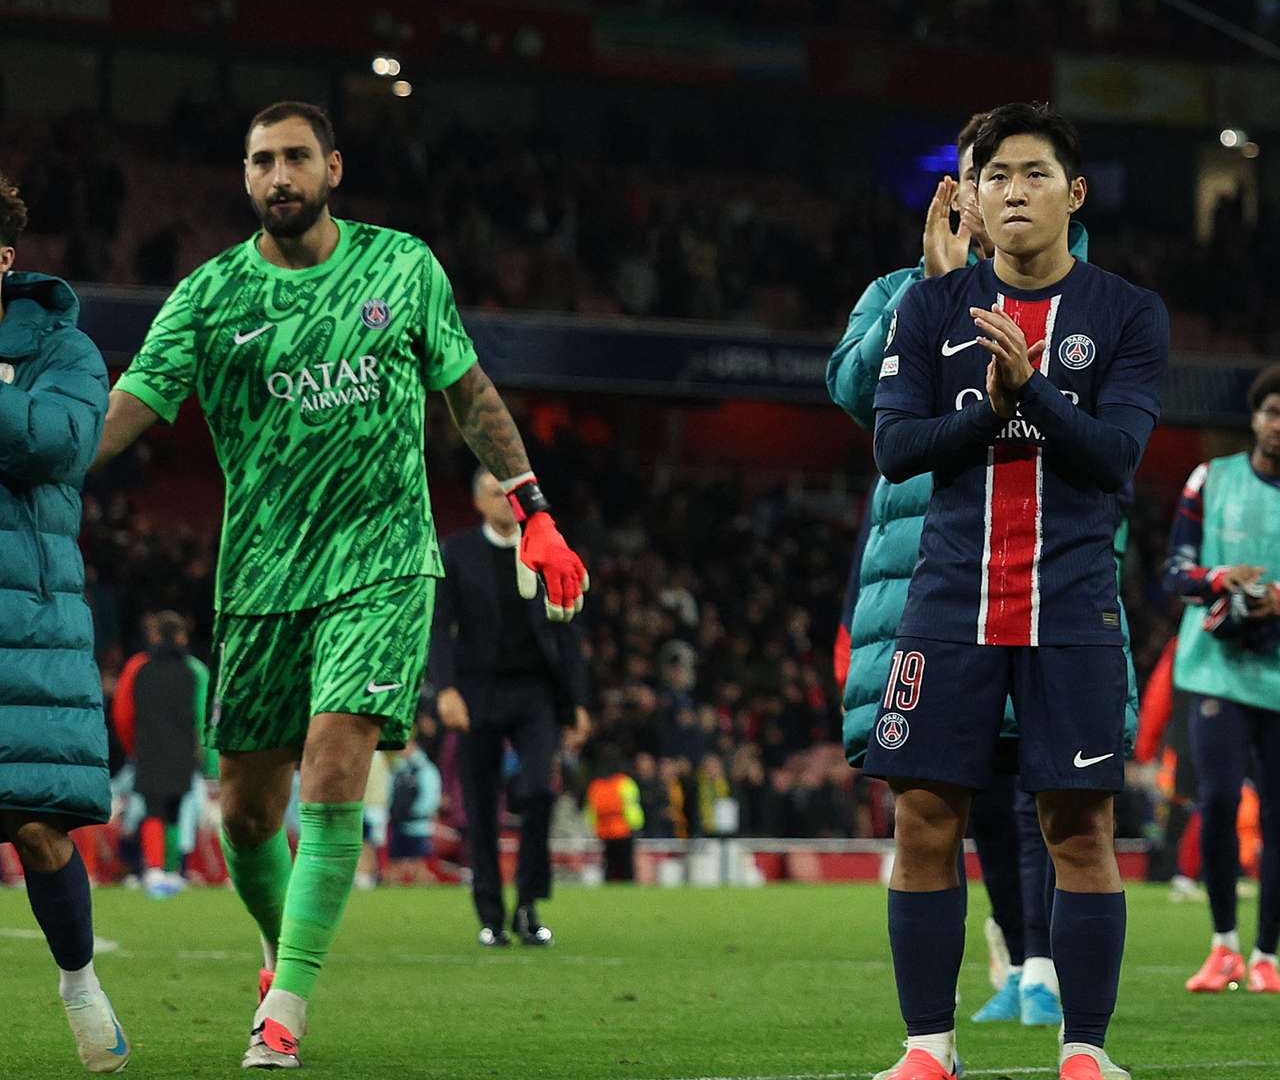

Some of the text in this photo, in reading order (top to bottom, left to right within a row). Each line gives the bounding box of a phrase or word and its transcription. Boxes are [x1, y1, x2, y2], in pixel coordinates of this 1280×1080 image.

[267, 355, 379, 401] QATAR
[300, 382, 380, 413] AIRWAYS
[883, 651, 925, 711] 19
